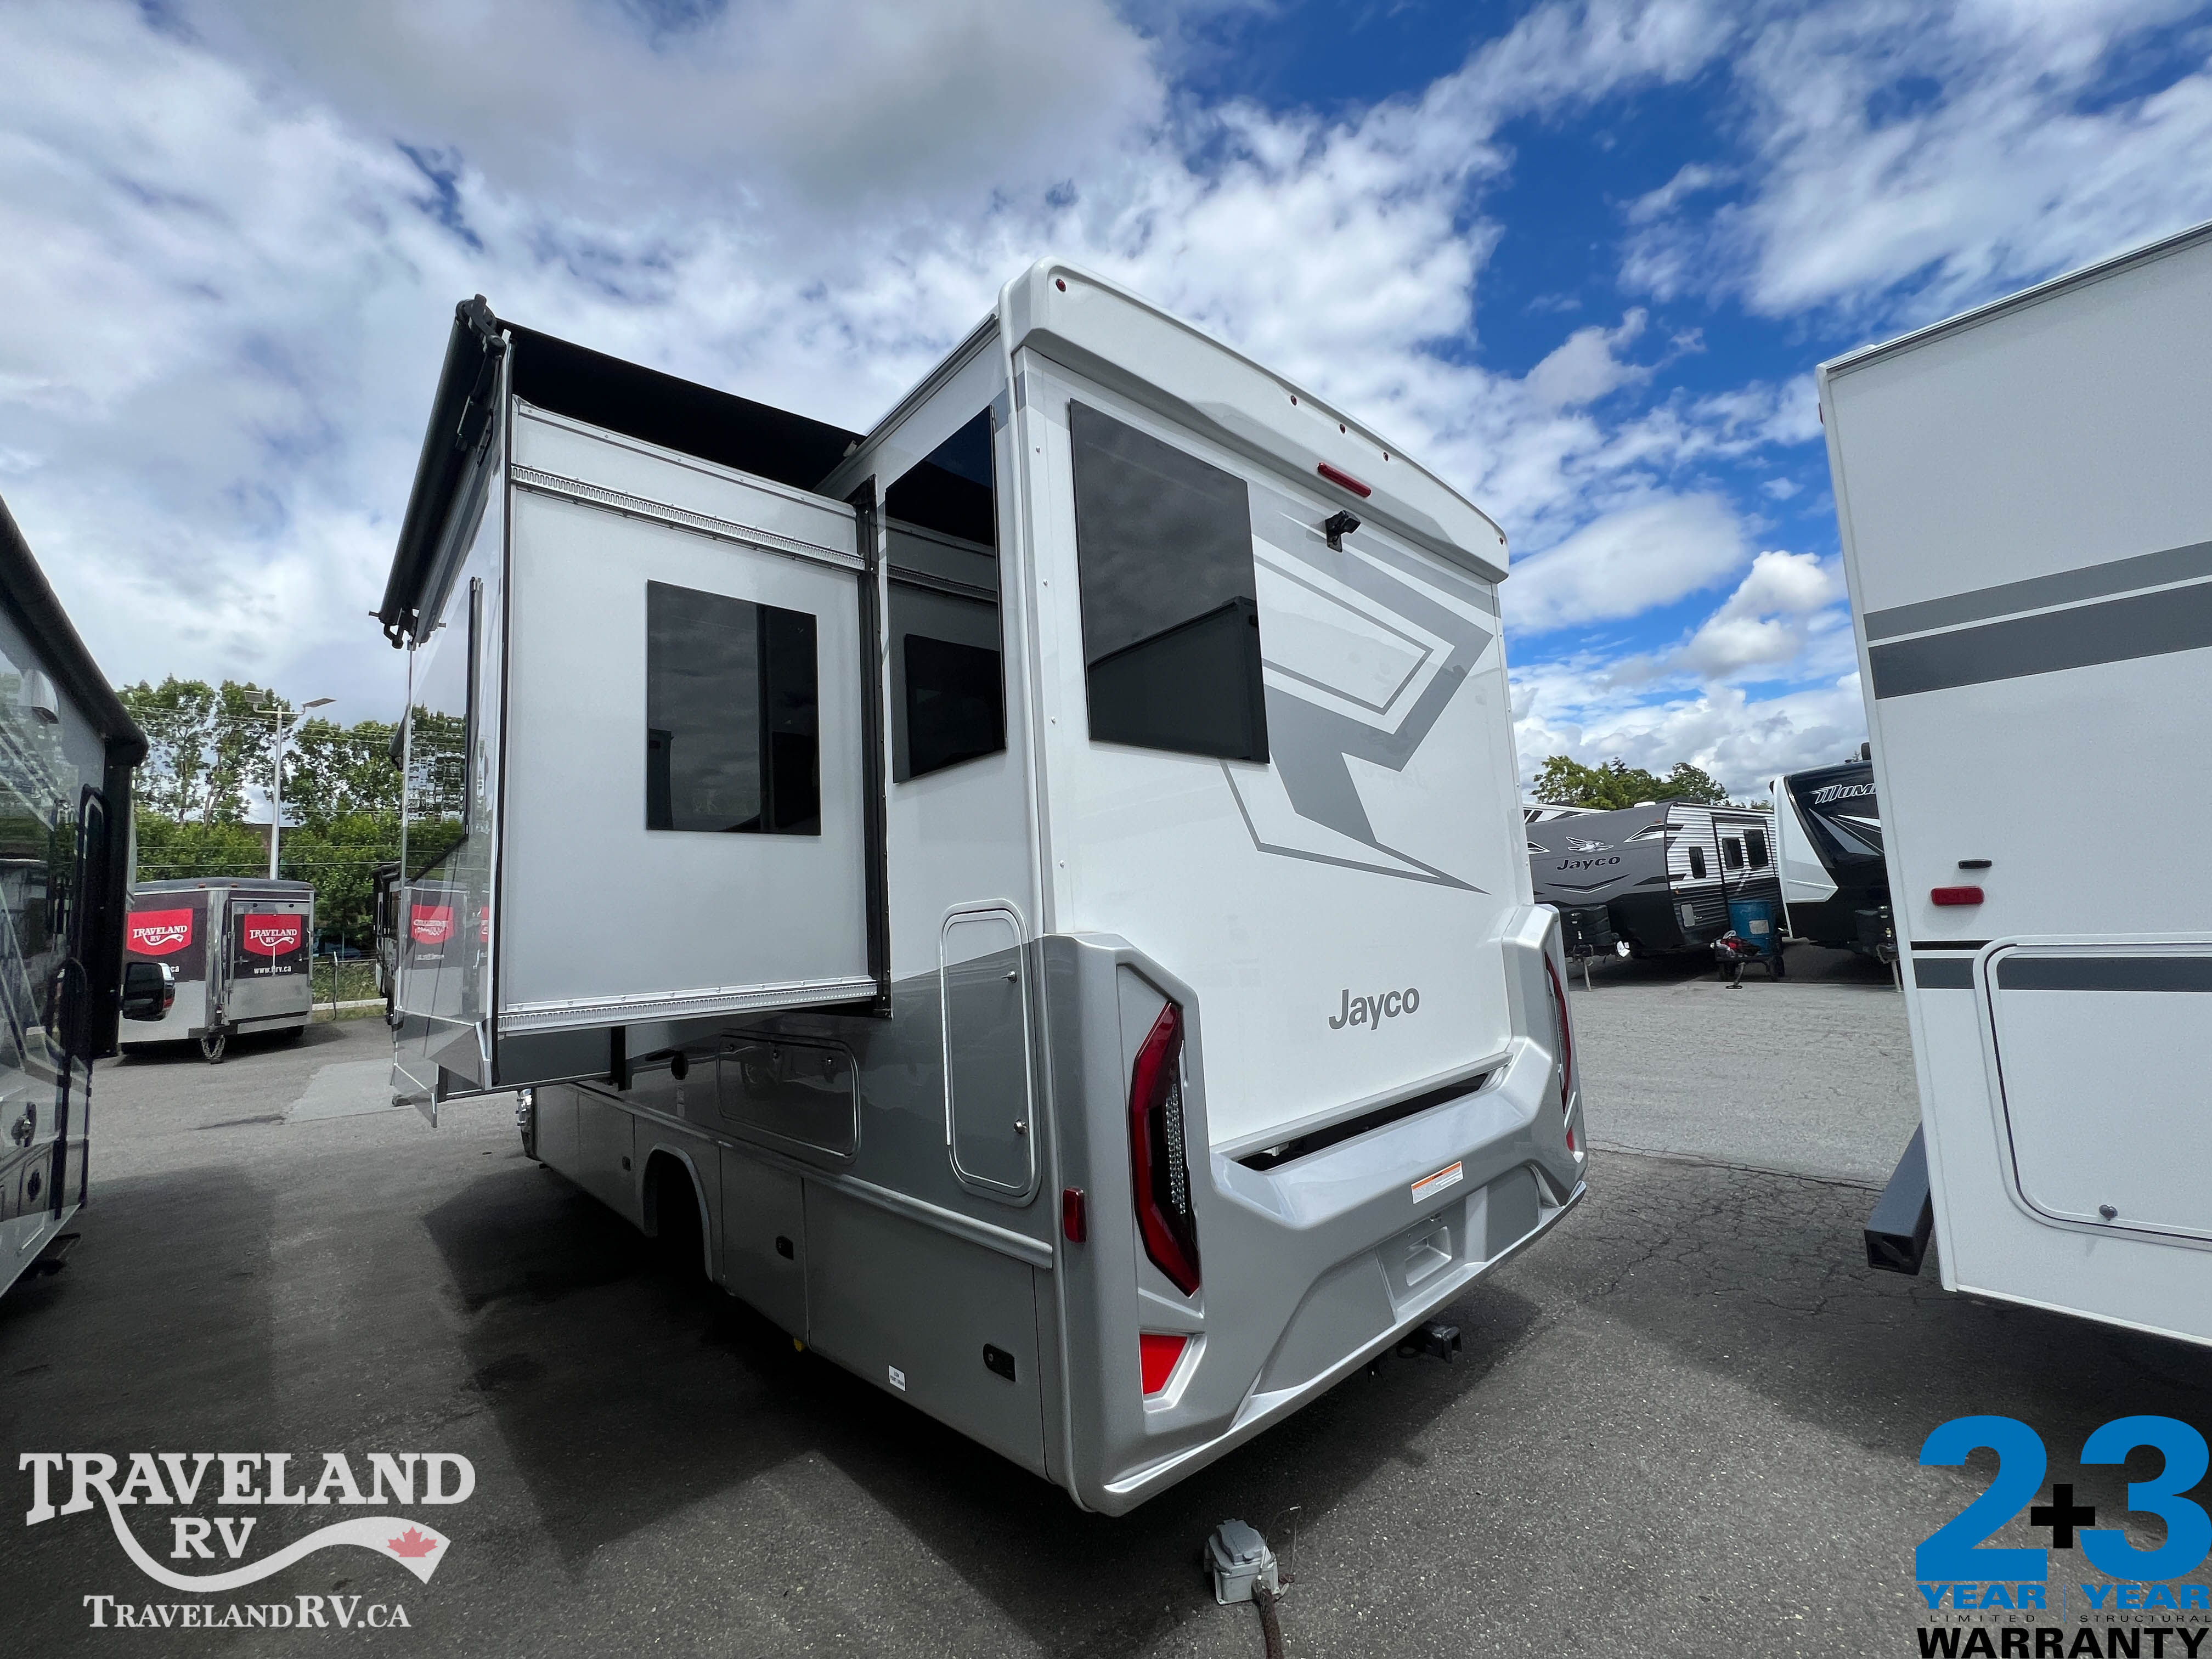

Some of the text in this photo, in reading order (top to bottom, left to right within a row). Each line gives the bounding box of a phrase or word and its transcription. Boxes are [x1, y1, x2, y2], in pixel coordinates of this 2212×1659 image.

[1556, 856, 1621, 871] Jayco
[133, 925, 188, 939] TRAVELAND
[249, 928, 297, 939] TRAVELAND
[1328, 988, 1420, 1030] Jayco
